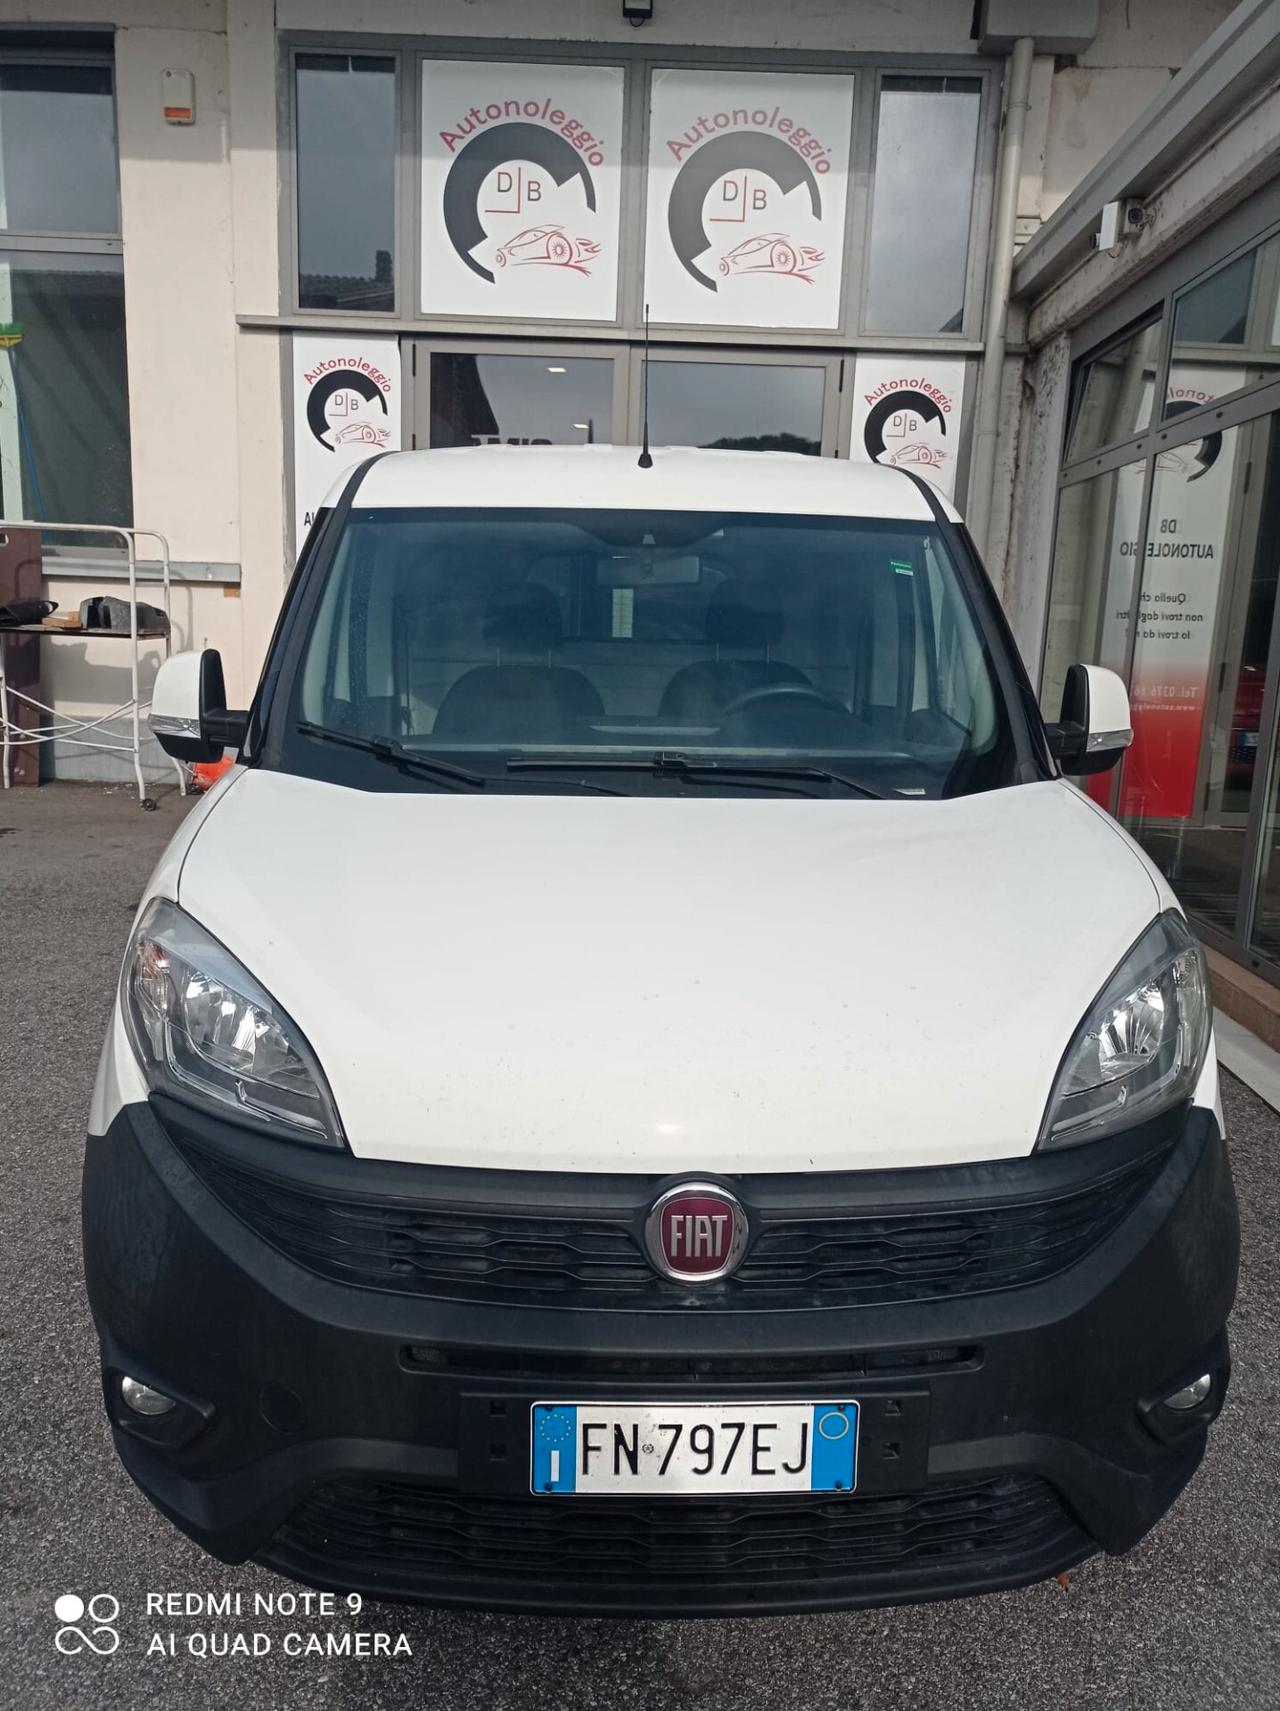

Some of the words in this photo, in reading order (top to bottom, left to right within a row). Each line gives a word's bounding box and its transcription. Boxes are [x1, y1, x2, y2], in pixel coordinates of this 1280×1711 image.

[439, 99, 604, 166] Autonoleggio
[666, 106, 832, 174] Autonoleggio
[303, 357, 392, 392] Autonoleggio
[863, 378, 953, 413] Autonoleggio
[671, 1214, 729, 1258] FIAT
